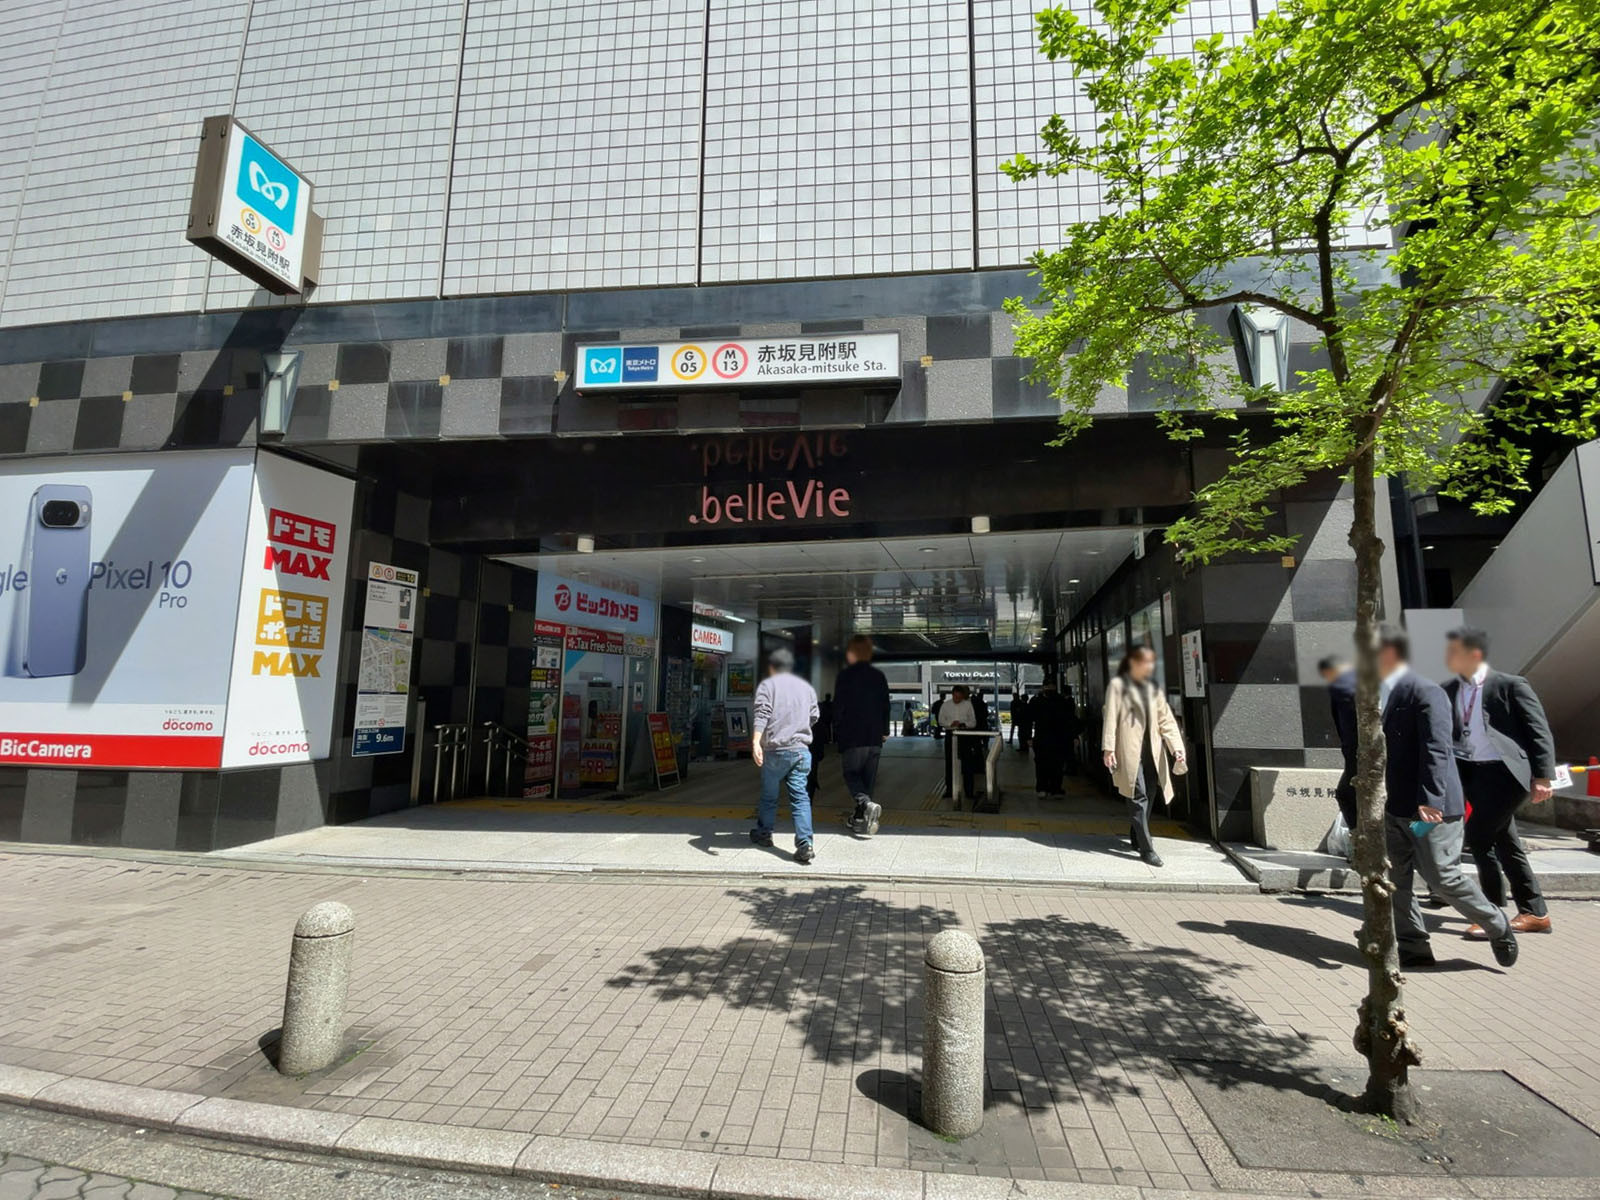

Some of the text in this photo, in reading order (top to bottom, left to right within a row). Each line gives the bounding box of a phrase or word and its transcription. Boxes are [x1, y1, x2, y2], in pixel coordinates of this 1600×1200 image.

[230, 224, 291, 271] 赤坂見附駅
[685, 351, 694, 361] G
[724, 350, 736, 360] M
[757, 342, 857, 363] 赤坂見附駅
[680, 362, 697, 373] 05
[722, 360, 739, 372] 13
[757, 360, 887, 375] Akasaka-mitsuke Sta.
[273, 515, 331, 548] ドコモ
[264, 546, 331, 581] MAX
[89, 560, 152, 590] Pixel
[160, 560, 193, 589] 10
[158, 592, 188, 609] Pro
[264, 595, 323, 622] ドコモ
[576, 591, 639, 622] ビックカメラ
[259, 620, 321, 643] ポイ活
[693, 629, 722, 646] CAMERA
[577, 637, 589, 651] Tax
[590, 639, 605, 652] Free
[607, 641, 624, 654] Store
[252, 651, 322, 677] MAX
[162, 718, 213, 731] docomo
[1, 738, 92, 758] BicCamera
[248, 741, 311, 756] docomo
